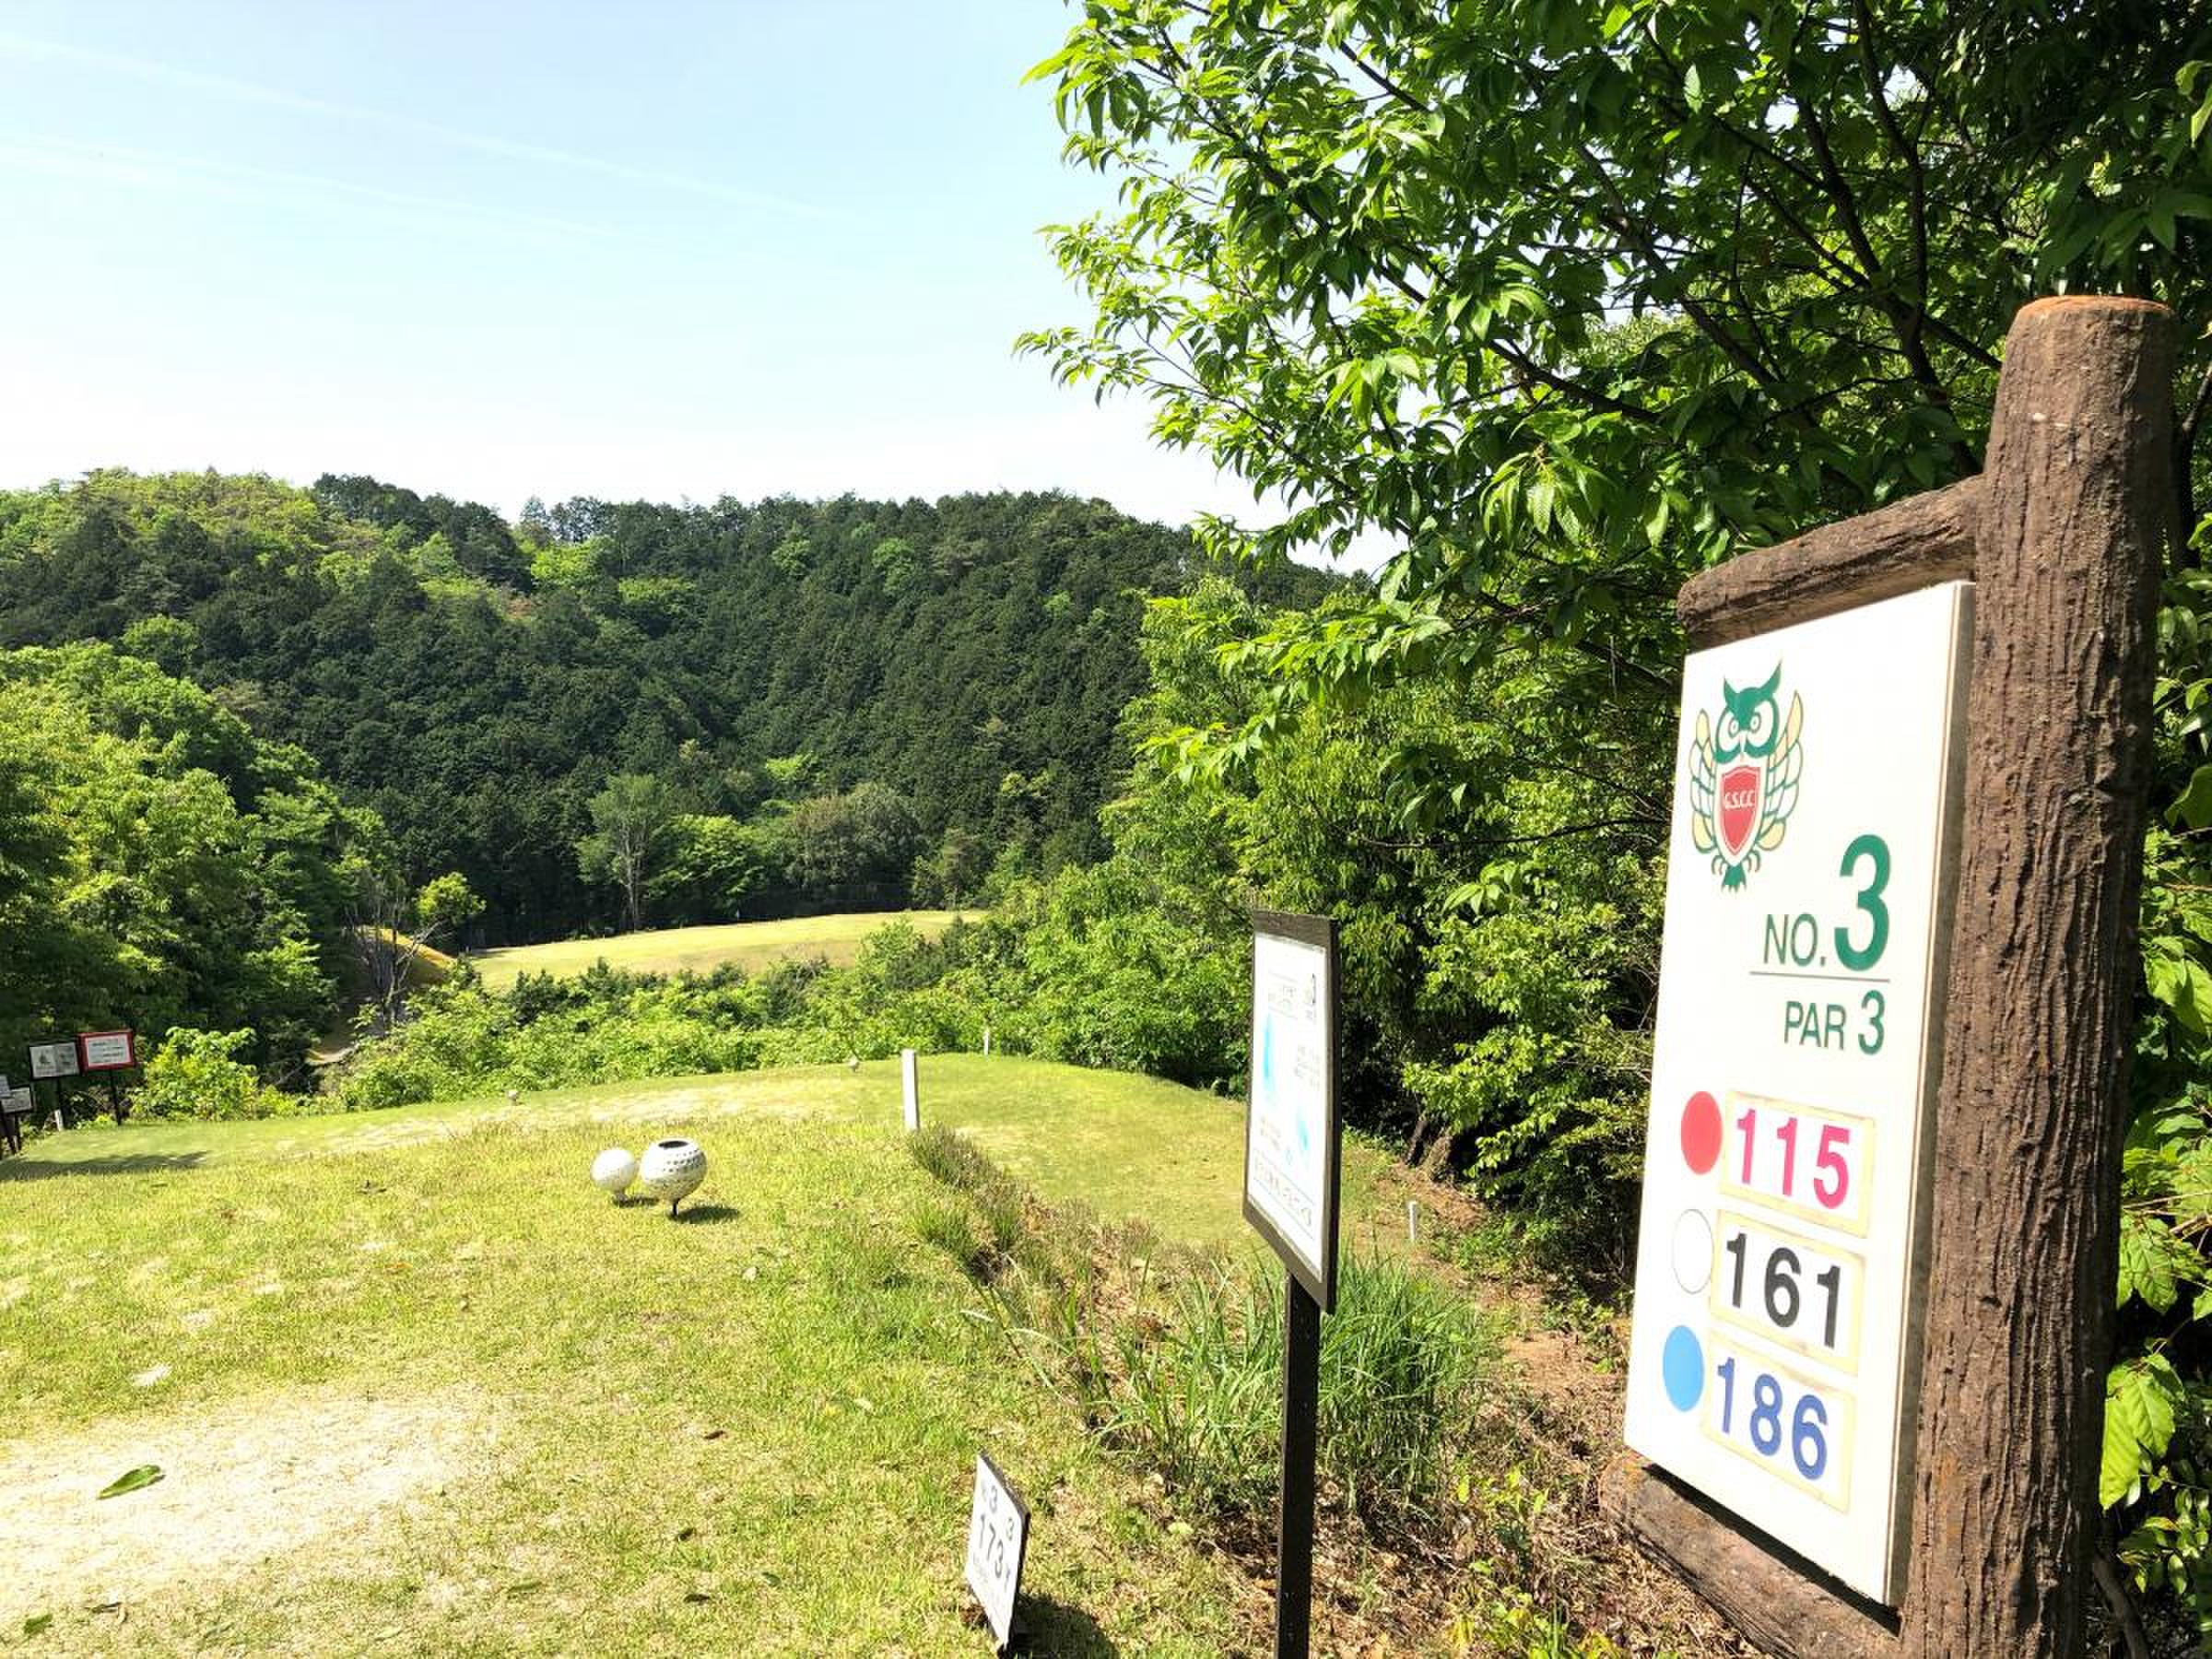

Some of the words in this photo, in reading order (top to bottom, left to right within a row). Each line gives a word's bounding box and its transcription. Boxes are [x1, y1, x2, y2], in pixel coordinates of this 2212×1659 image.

[1783, 1001, 1847, 1050] PAR
[1857, 990, 1885, 1055] 3
[1736, 1109, 1851, 1209] 115
[1726, 1232, 1841, 1349] 161
[1717, 1357, 1829, 1480] 186
